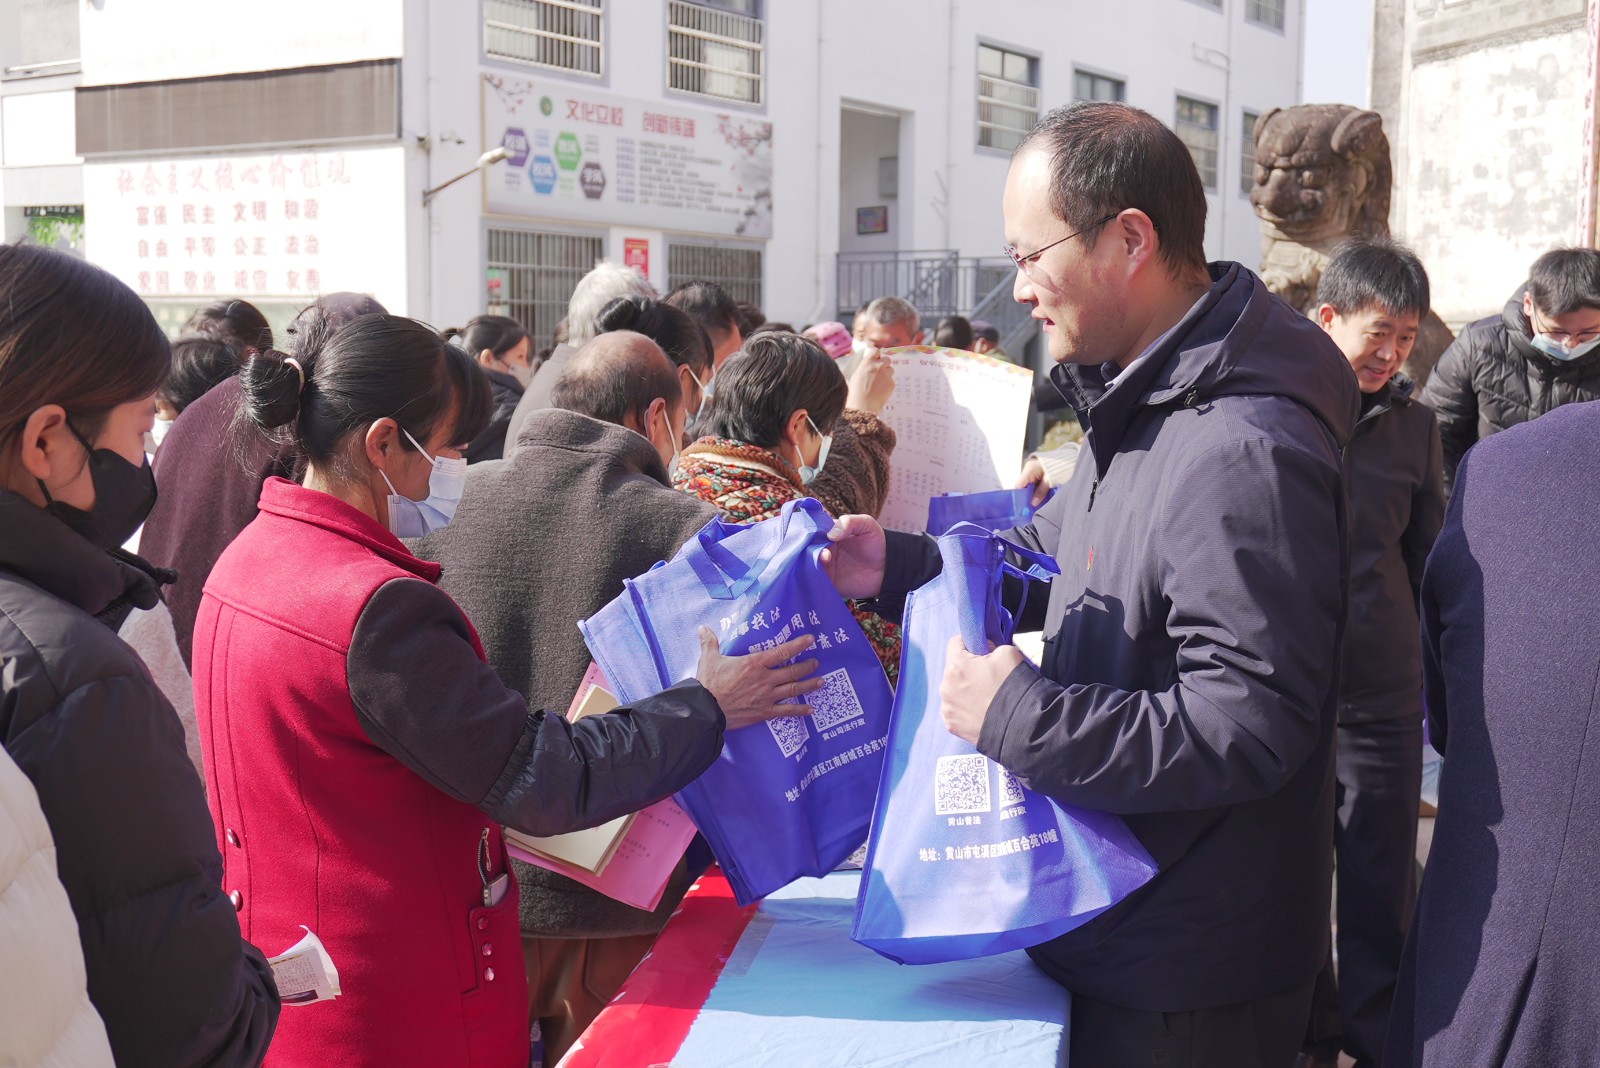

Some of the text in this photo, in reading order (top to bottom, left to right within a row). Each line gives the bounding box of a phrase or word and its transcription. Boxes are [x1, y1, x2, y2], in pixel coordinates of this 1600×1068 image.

[565, 98, 625, 128] 文化立校
[182, 203, 215, 224] 民主
[233, 200, 268, 224] 文明
[138, 238, 168, 259] 自由
[233, 235, 268, 257] 公正
[821, 717, 867, 743] 黄山司法行政
[947, 815, 982, 827] 黄山普法
